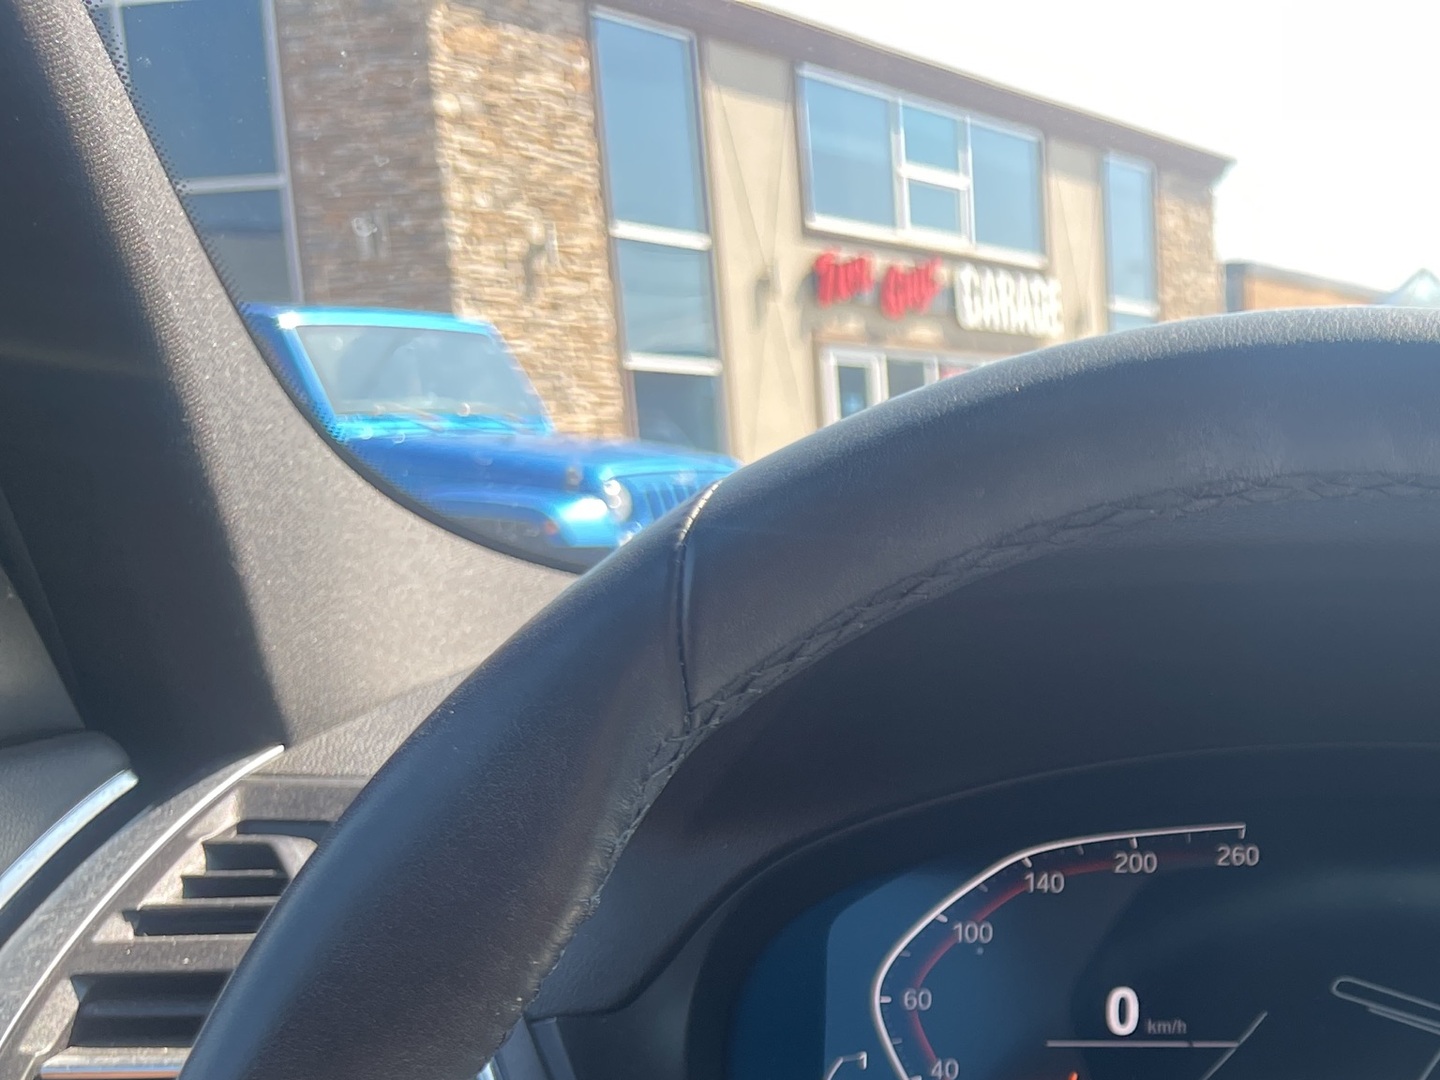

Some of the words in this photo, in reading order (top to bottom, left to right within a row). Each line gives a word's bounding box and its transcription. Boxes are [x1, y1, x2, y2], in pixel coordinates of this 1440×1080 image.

[956, 262, 1064, 338] GARAGE
[1113, 851, 1158, 874] 200
[1216, 843, 1260, 867] 260
[1024, 871, 1066, 894] 140
[952, 920, 994, 944] 100
[903, 987, 933, 1011] 60
[1104, 985, 1141, 1037] 0
[1146, 1018, 1188, 1036] km/h
